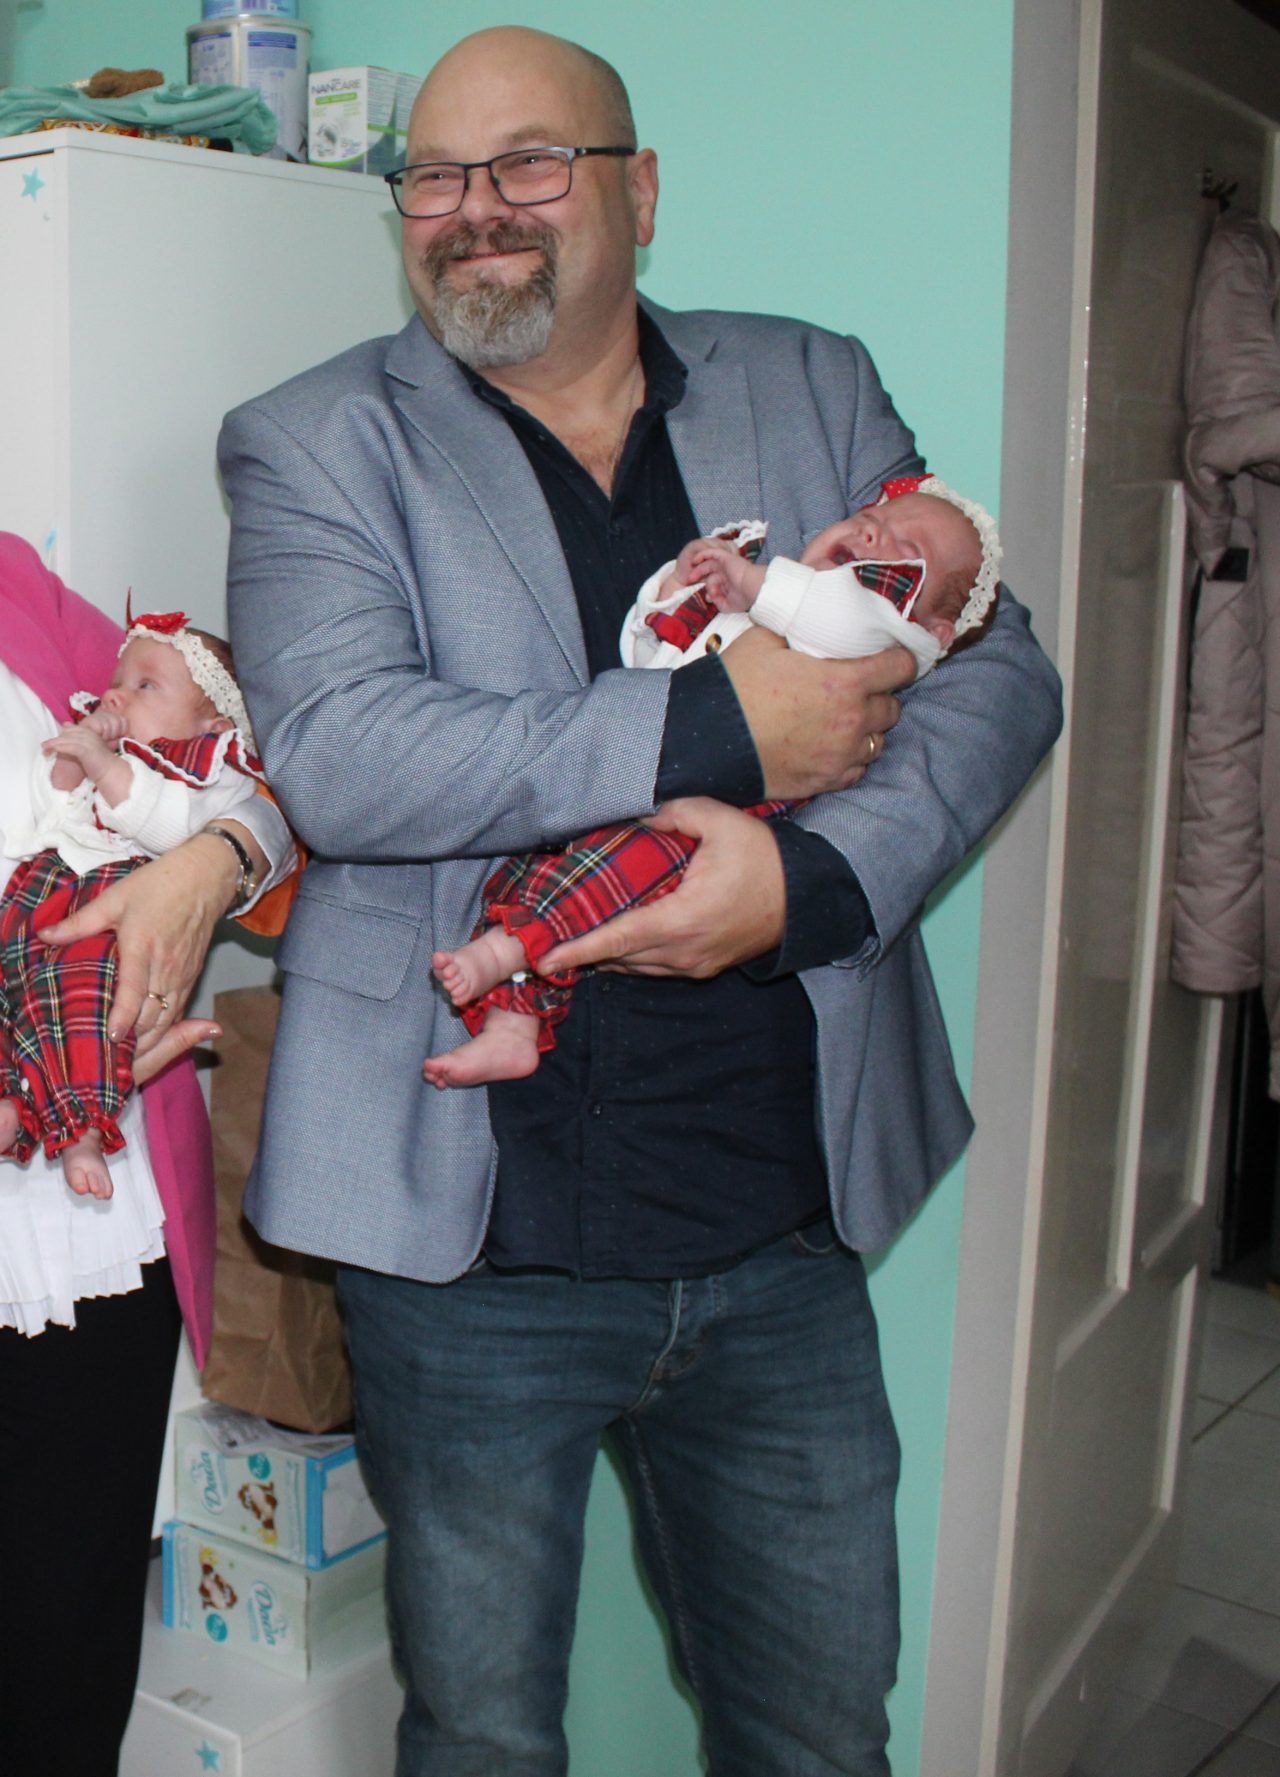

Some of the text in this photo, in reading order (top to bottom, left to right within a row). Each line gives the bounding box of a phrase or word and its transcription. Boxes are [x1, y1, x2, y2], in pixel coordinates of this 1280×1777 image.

[311, 79, 361, 94] NANCARE
[200, 1452, 220, 1508] Dada
[256, 1588, 279, 1646] Dada
